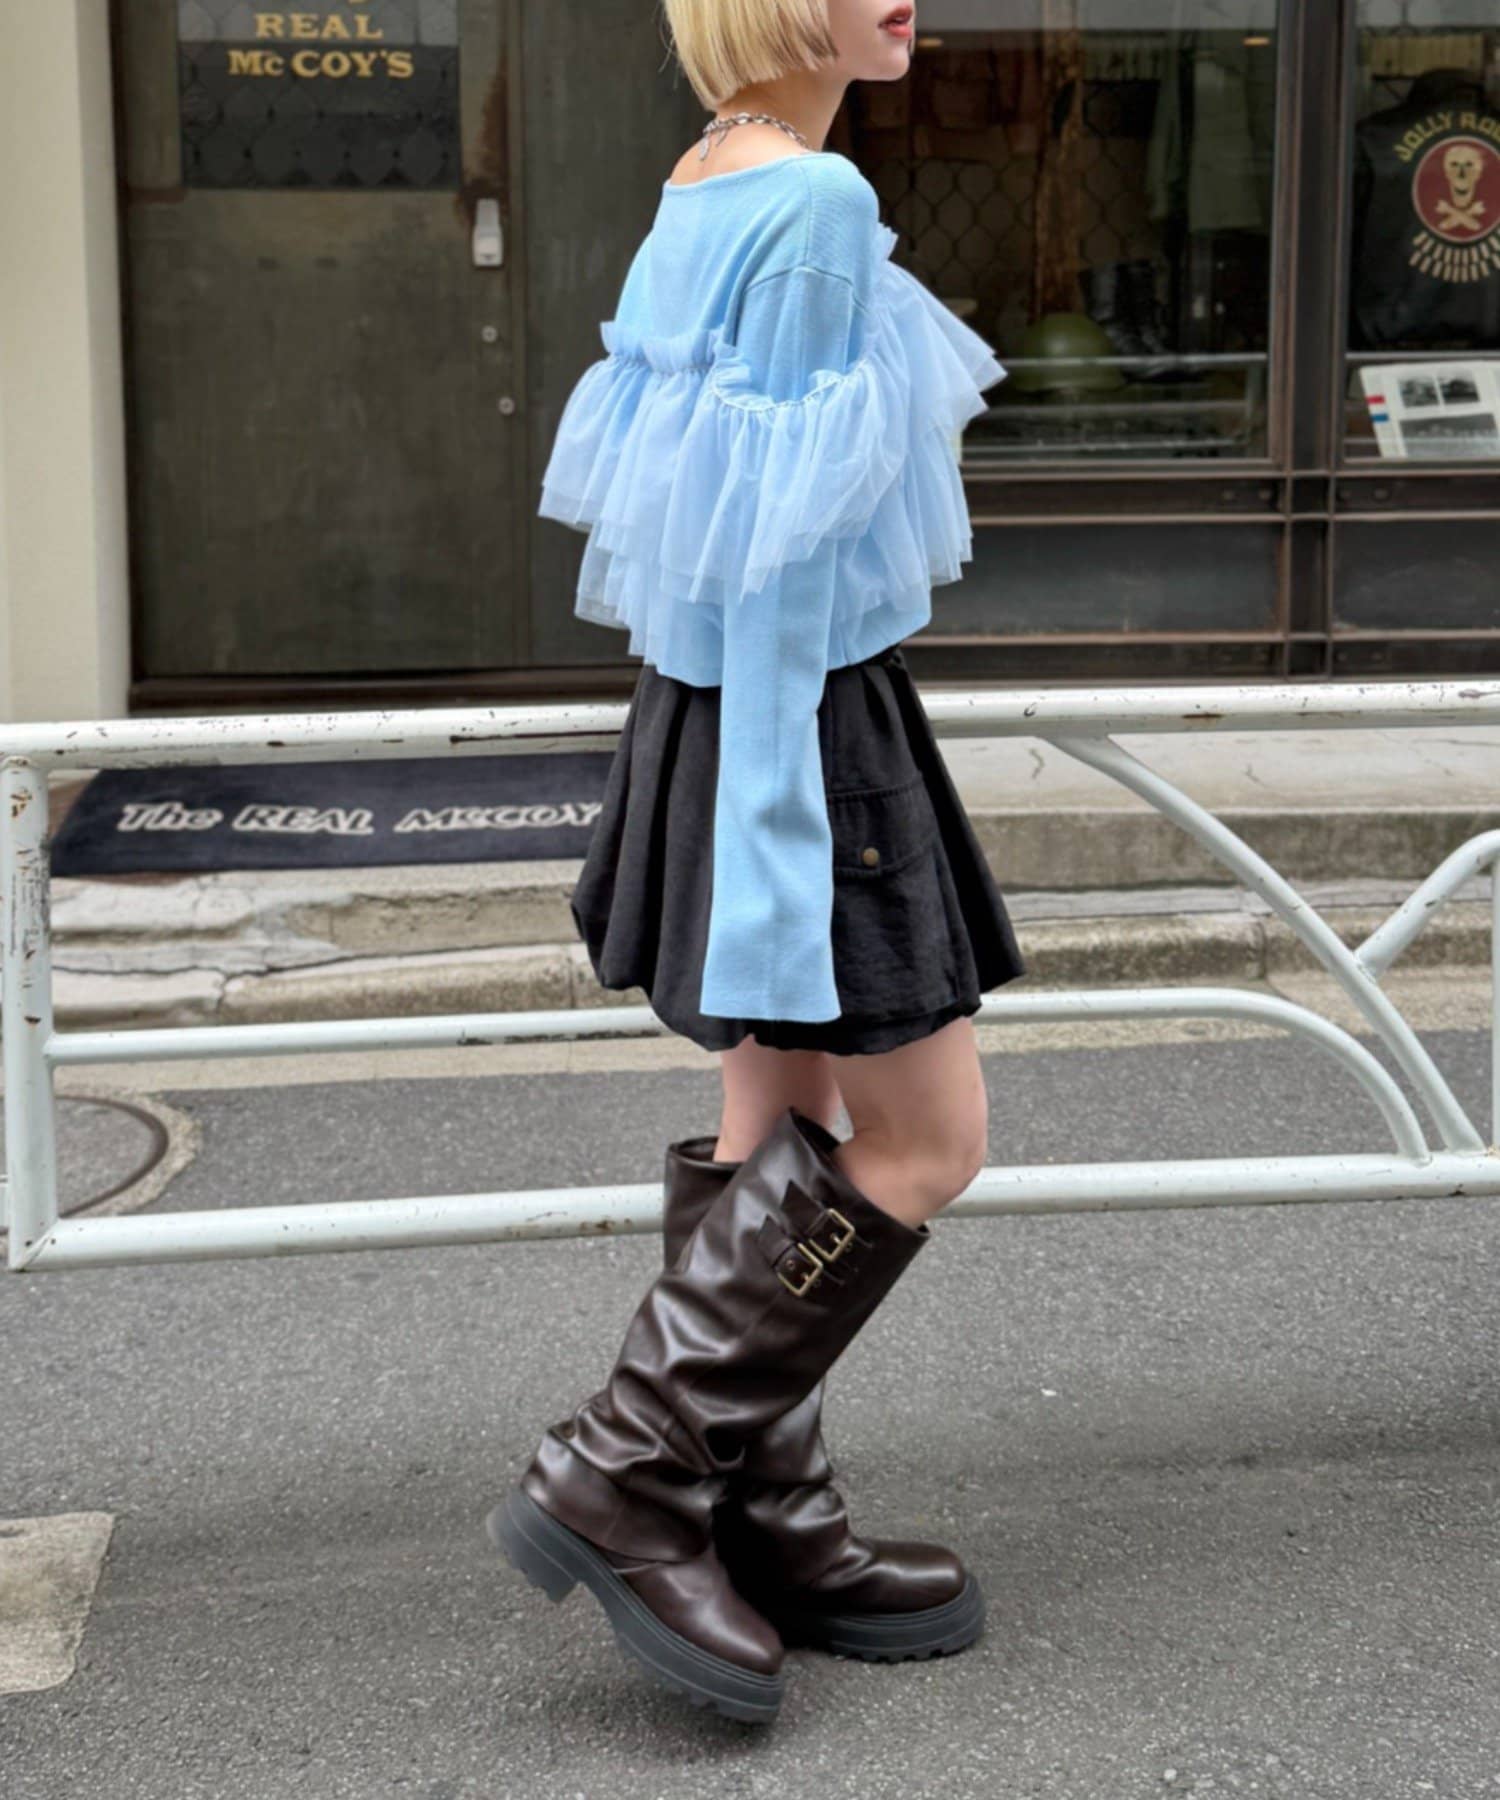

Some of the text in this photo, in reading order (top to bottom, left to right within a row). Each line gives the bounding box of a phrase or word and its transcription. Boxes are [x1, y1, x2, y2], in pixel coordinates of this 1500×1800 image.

[254, 13, 384, 40] REAL
[1392, 111, 1454, 162] JOLLY
[117, 801, 224, 831] The
[231, 803, 374, 835] REAL
